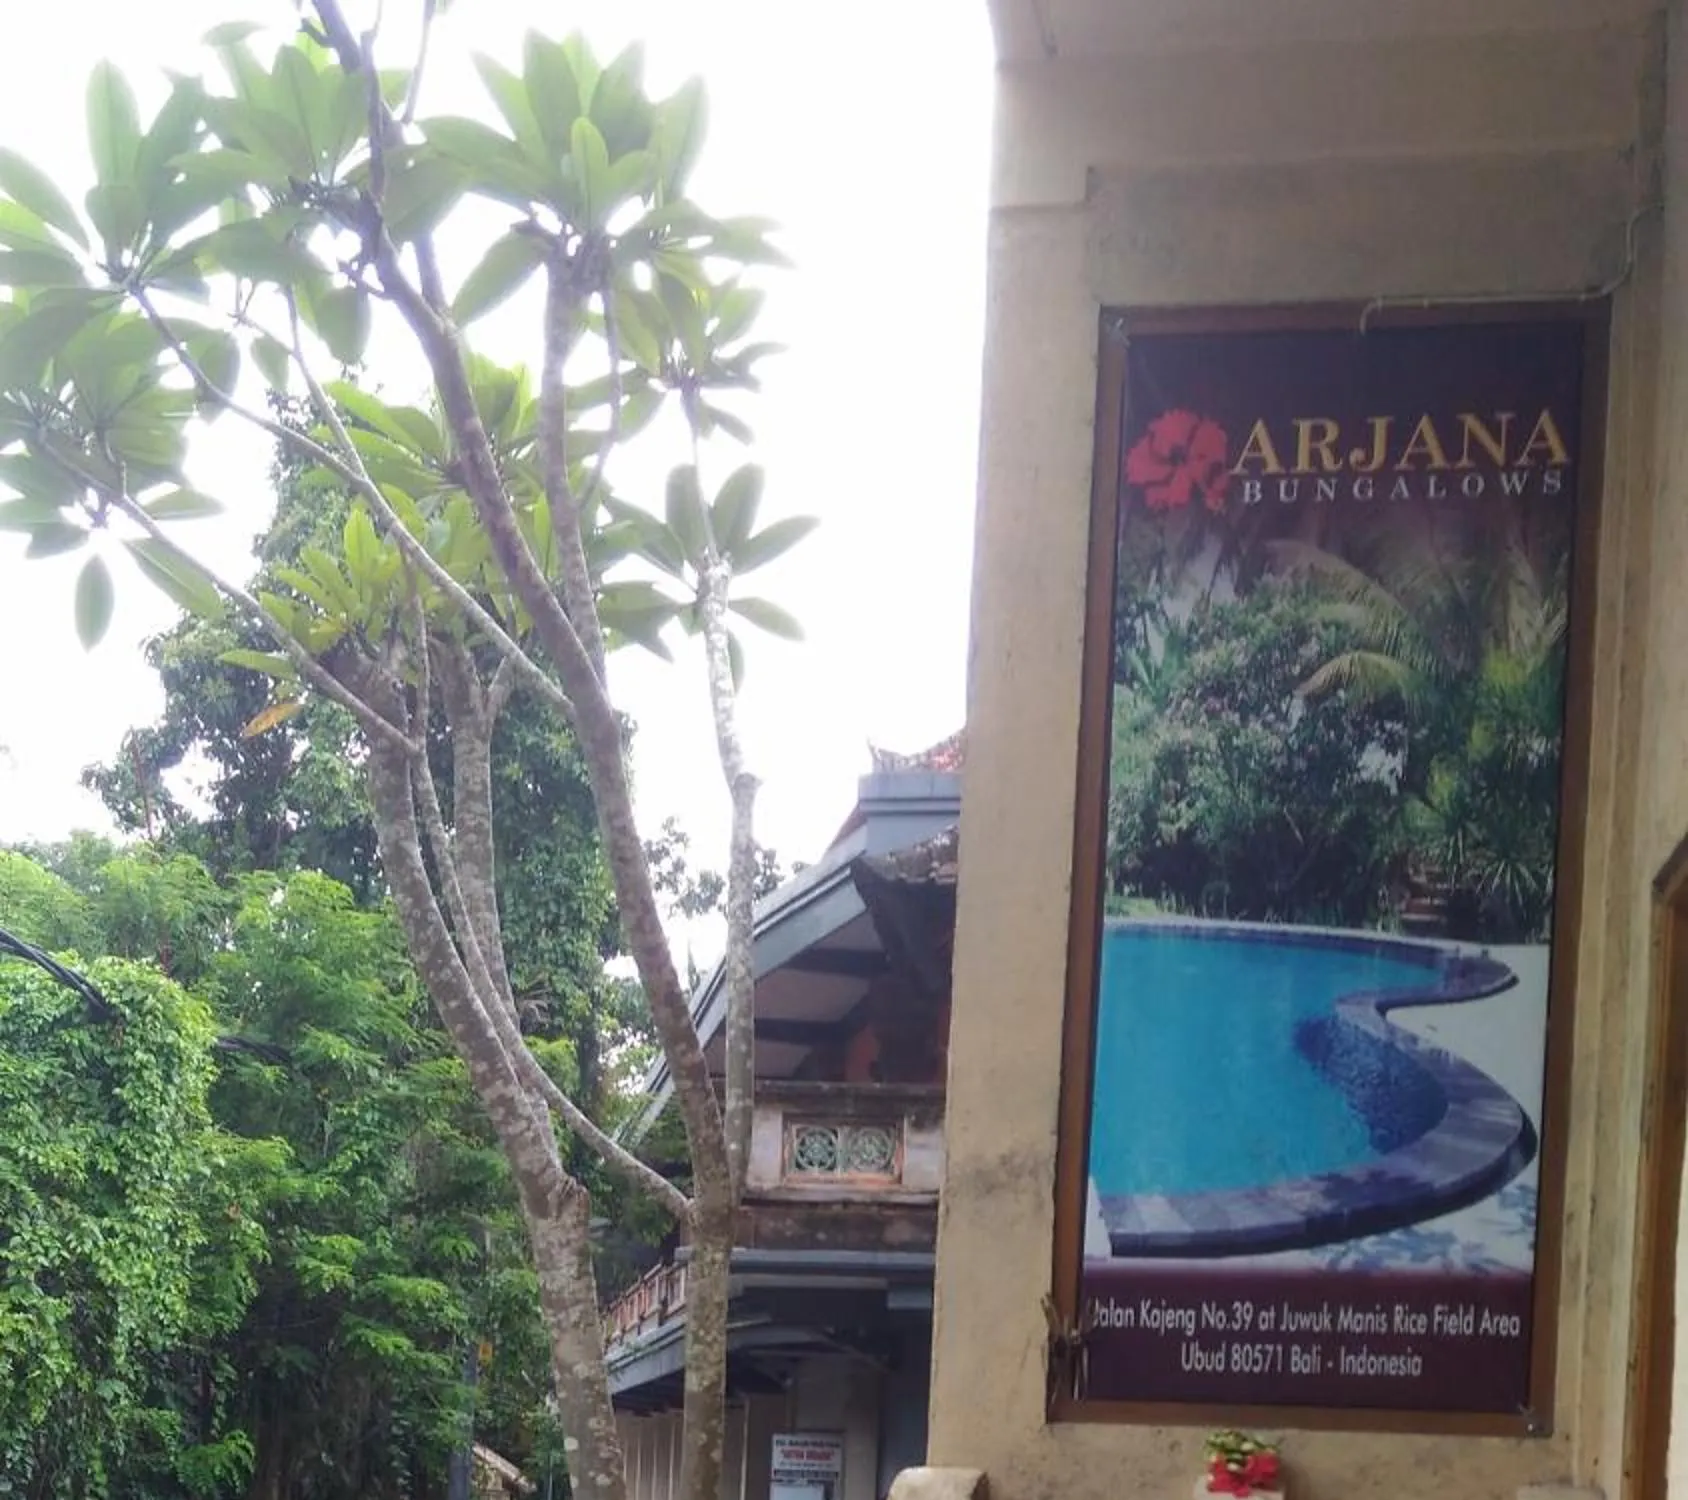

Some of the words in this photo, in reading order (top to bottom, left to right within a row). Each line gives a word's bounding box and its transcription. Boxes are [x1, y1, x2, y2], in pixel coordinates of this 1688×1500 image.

[1230, 408, 1569, 475] ARJANA
[1242, 470, 1563, 505] BUNGALOWS
[1139, 1299, 1196, 1336] Kajeng
[1201, 1300, 1253, 1331] No.39
[1259, 1305, 1276, 1332] at
[1280, 1301, 1332, 1333] Juwuk
[1337, 1303, 1388, 1334] Manis
[1394, 1303, 1428, 1336] Rice
[1433, 1303, 1475, 1336] Field
[1479, 1307, 1521, 1337] Area
[1181, 1341, 1226, 1371] Ubud
[1231, 1343, 1283, 1373] 80571
[1290, 1343, 1322, 1375] Bali
[1339, 1344, 1423, 1377] Indonesia
